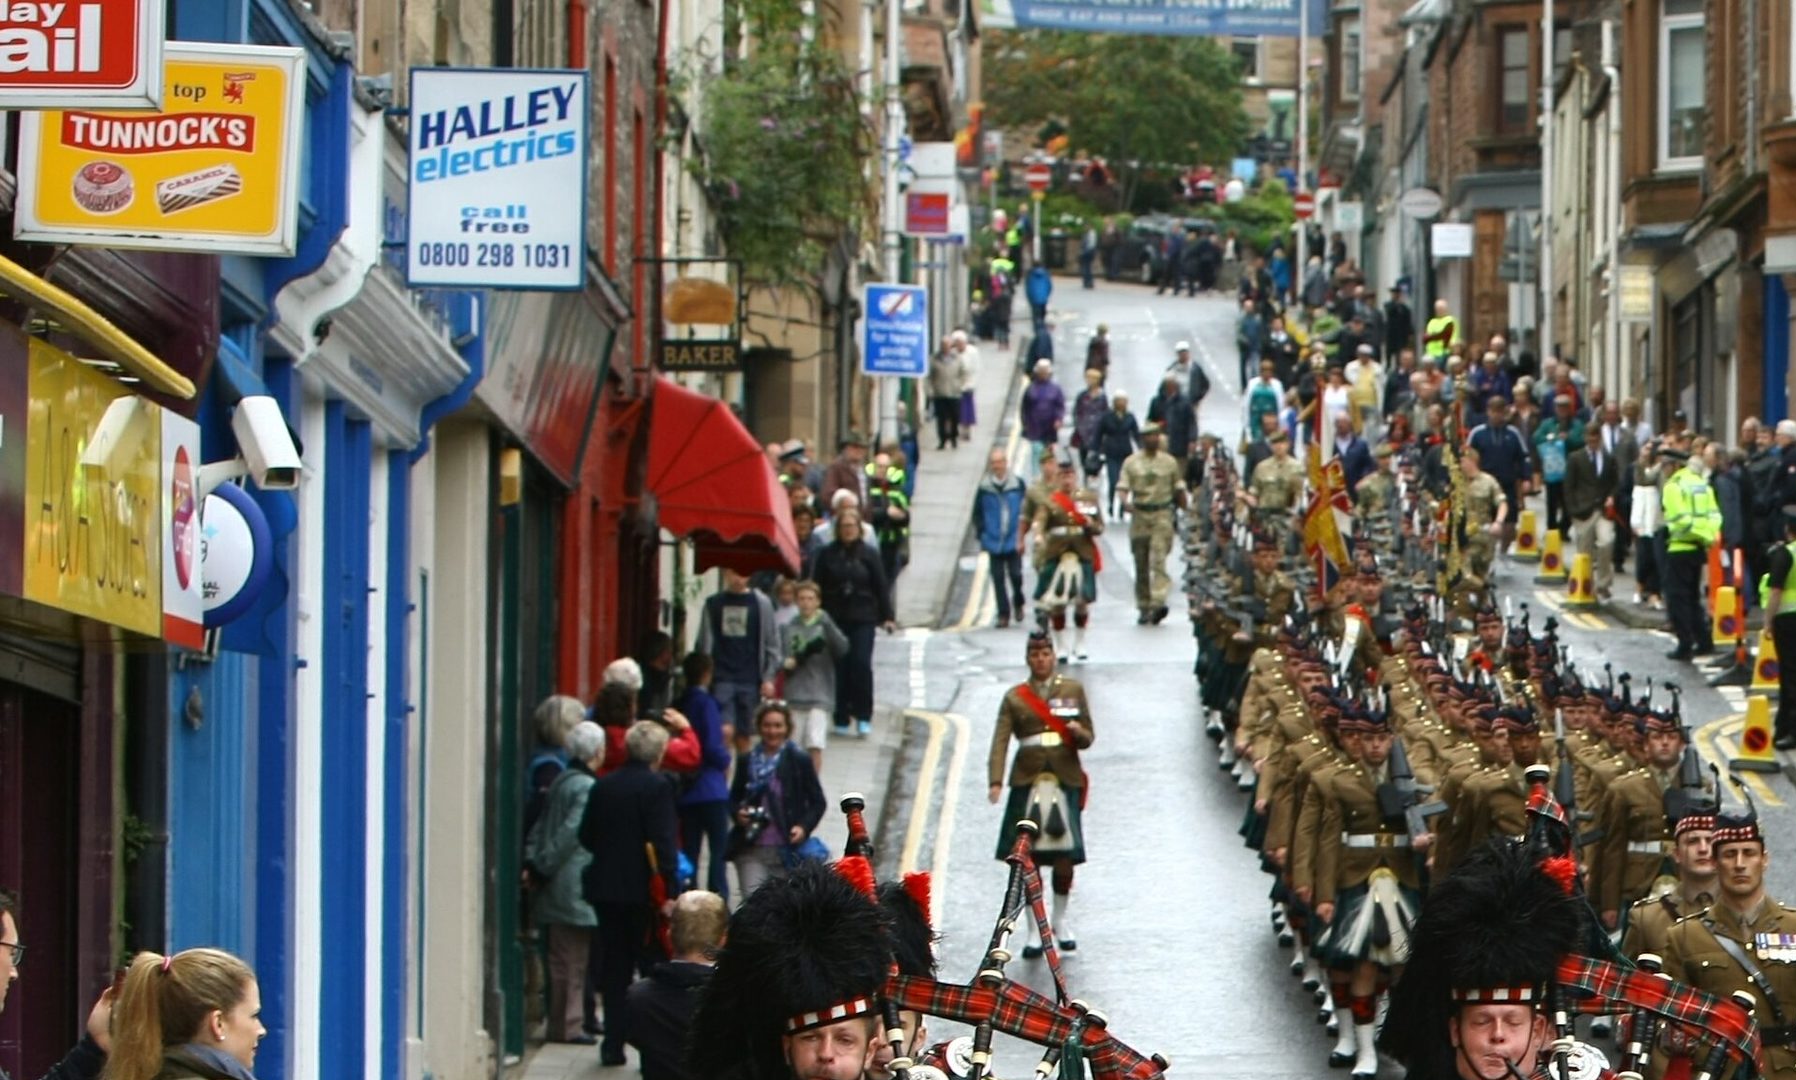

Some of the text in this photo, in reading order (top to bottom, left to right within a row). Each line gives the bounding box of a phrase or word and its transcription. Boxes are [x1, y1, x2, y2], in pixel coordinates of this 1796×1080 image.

[173, 83, 207, 101] top
[418, 82, 577, 150] HALLEY
[70, 115, 247, 149] TUNNOCK'S
[415, 130, 576, 183] electrics
[461, 205, 527, 219] call
[460, 219, 530, 233] free
[419, 242, 570, 267] 0800 298 1031
[664, 345, 736, 365] BAKER
